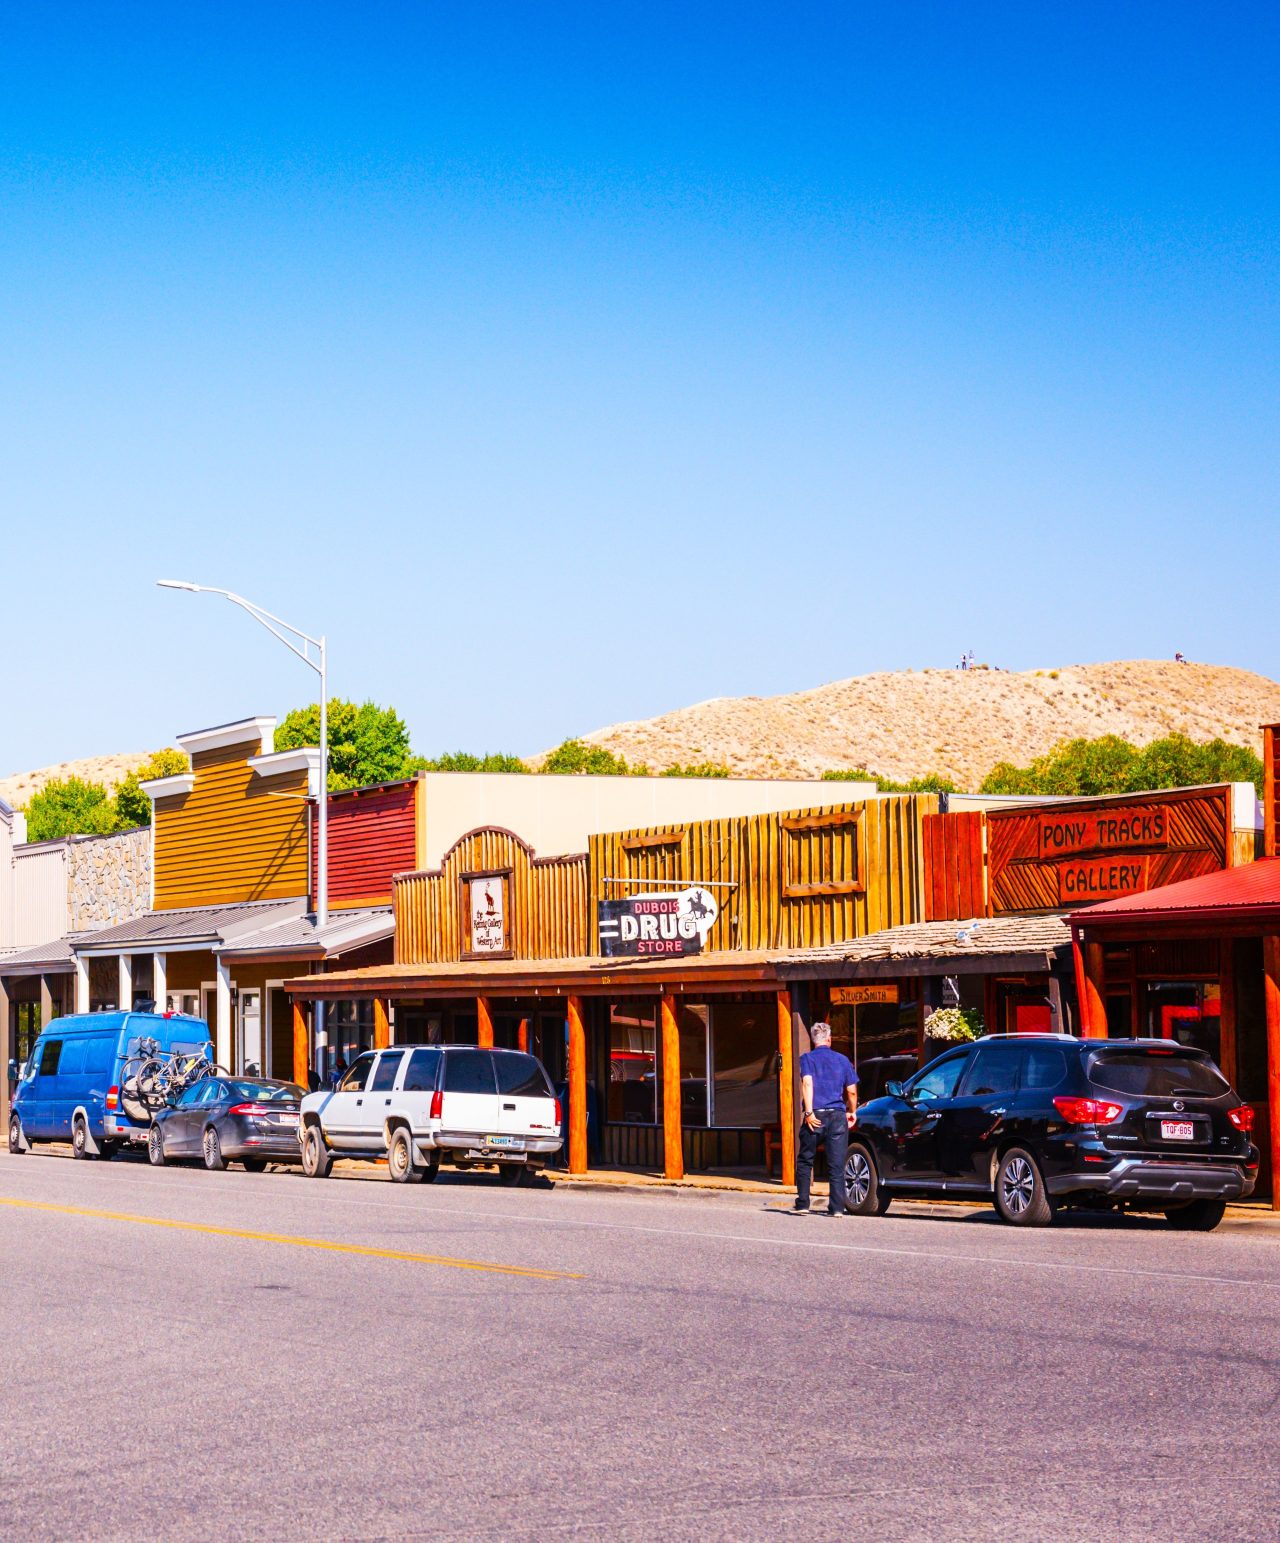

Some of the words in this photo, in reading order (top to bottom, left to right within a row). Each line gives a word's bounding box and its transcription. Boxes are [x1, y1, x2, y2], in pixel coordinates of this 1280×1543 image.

[1044, 823, 1086, 848] PONY
[1097, 815, 1163, 844] TRACKS
[1065, 865, 1142, 892] GALLERY
[634, 901, 680, 914] DUBOIS
[620, 913, 697, 941] DRUG
[638, 940, 683, 953] STORE
